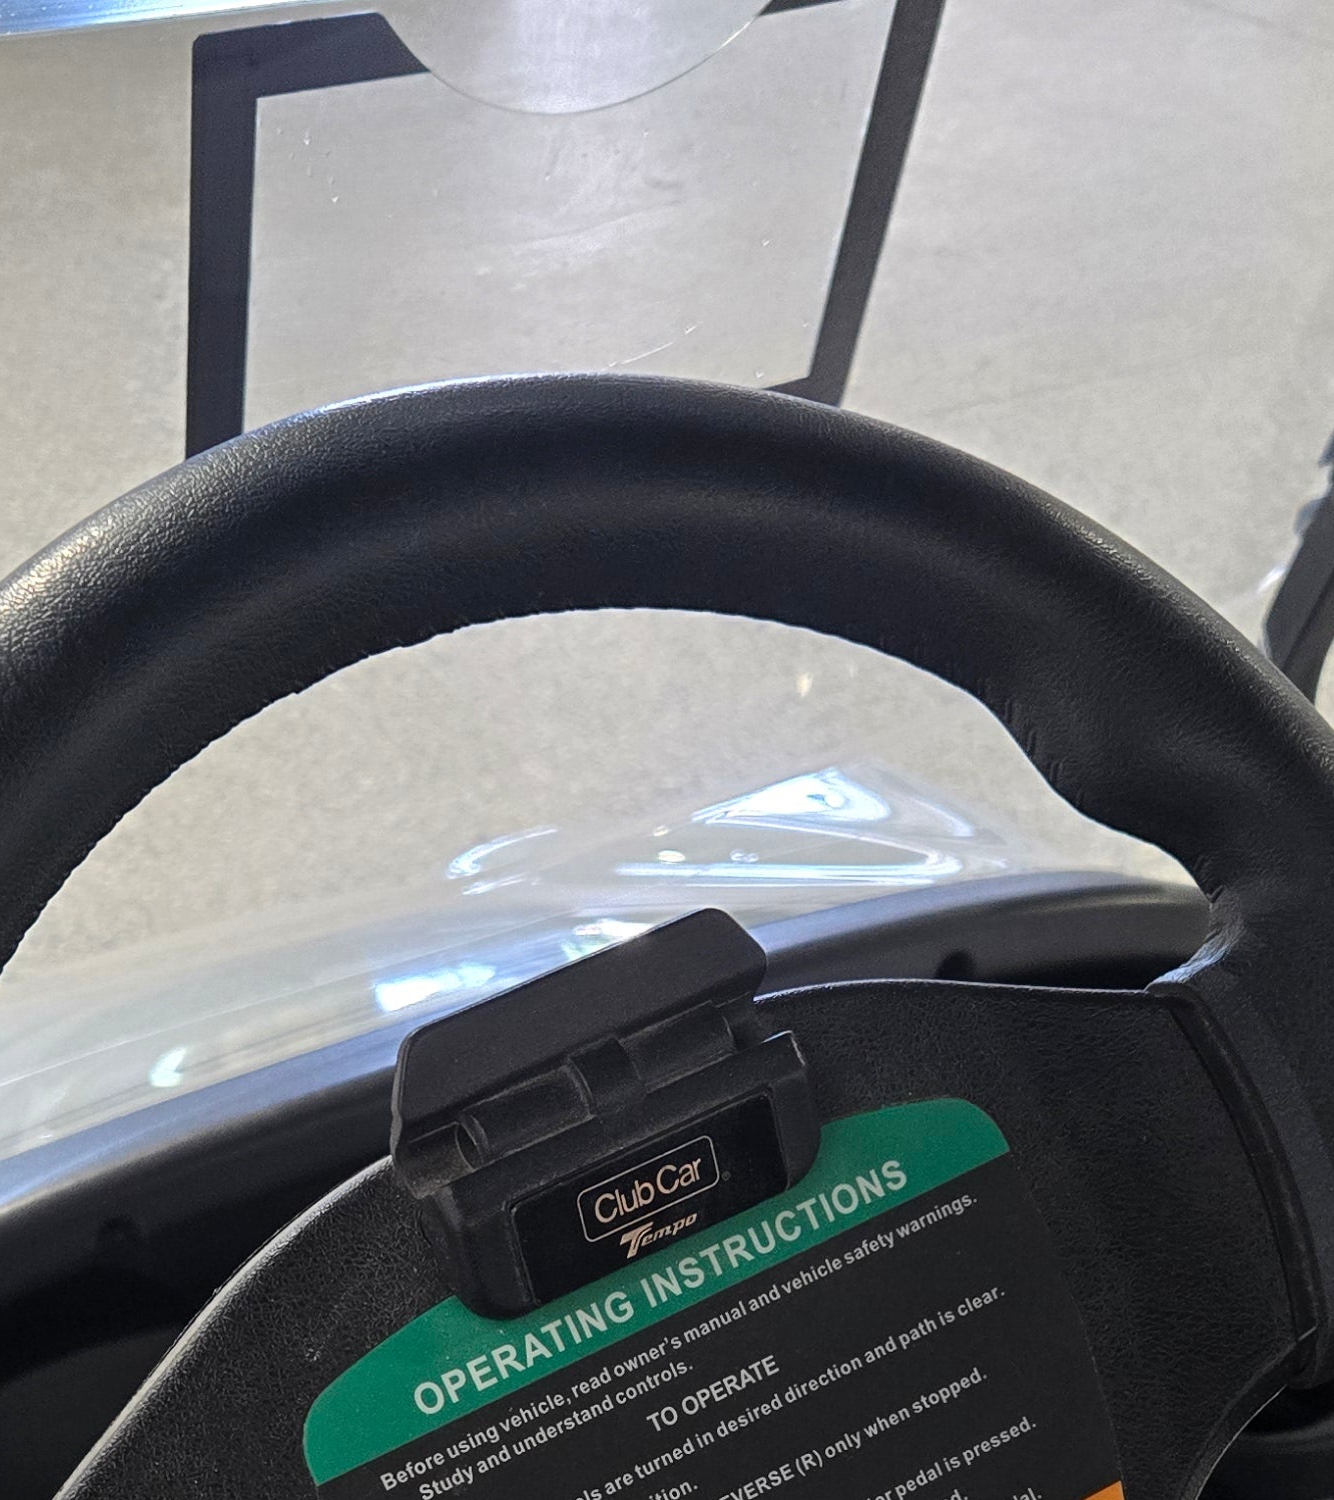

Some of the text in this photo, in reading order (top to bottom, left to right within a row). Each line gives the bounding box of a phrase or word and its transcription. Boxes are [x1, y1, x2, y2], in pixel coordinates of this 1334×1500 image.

[594, 1158, 701, 1223] Club Car
[620, 1213, 697, 1259] Tempo
[414, 1161, 906, 1414] OPERATING INSTRUCTIONS
[380, 1453, 445, 1491] Before
[446, 1425, 500, 1459] using
[499, 1394, 571, 1432] vehicle,
[571, 1367, 612, 1398] read
[683, 1301, 747, 1343] manual
[748, 1284, 781, 1311] and
[781, 1258, 842, 1294] vehicle
[844, 1231, 894, 1264] safety
[896, 1195, 977, 1238] warnings.
[605, 1473, 634, 1495] are
[634, 1438, 695, 1479] turned
[695, 1432, 715, 1448] in
[717, 1393, 783, 1437] desired
[785, 1357, 863, 1403] direction
[864, 1336, 897, 1363] and
[898, 1318, 937, 1350] path
[937, 1311, 955, 1326] is
[958, 1287, 1005, 1316] clear.
[646, 1355, 779, 1431] TO OPERATE
[419, 1362, 693, 1500] Study and understand controls.
[795, 1450, 823, 1476] (R)
[825, 1431, 861, 1458] only
[863, 1408, 910, 1438] when
[912, 1367, 987, 1413] stopped.
[895, 1462, 943, 1500] pedal
[943, 1457, 961, 1472] is
[962, 1416, 1036, 1466] pressed.
